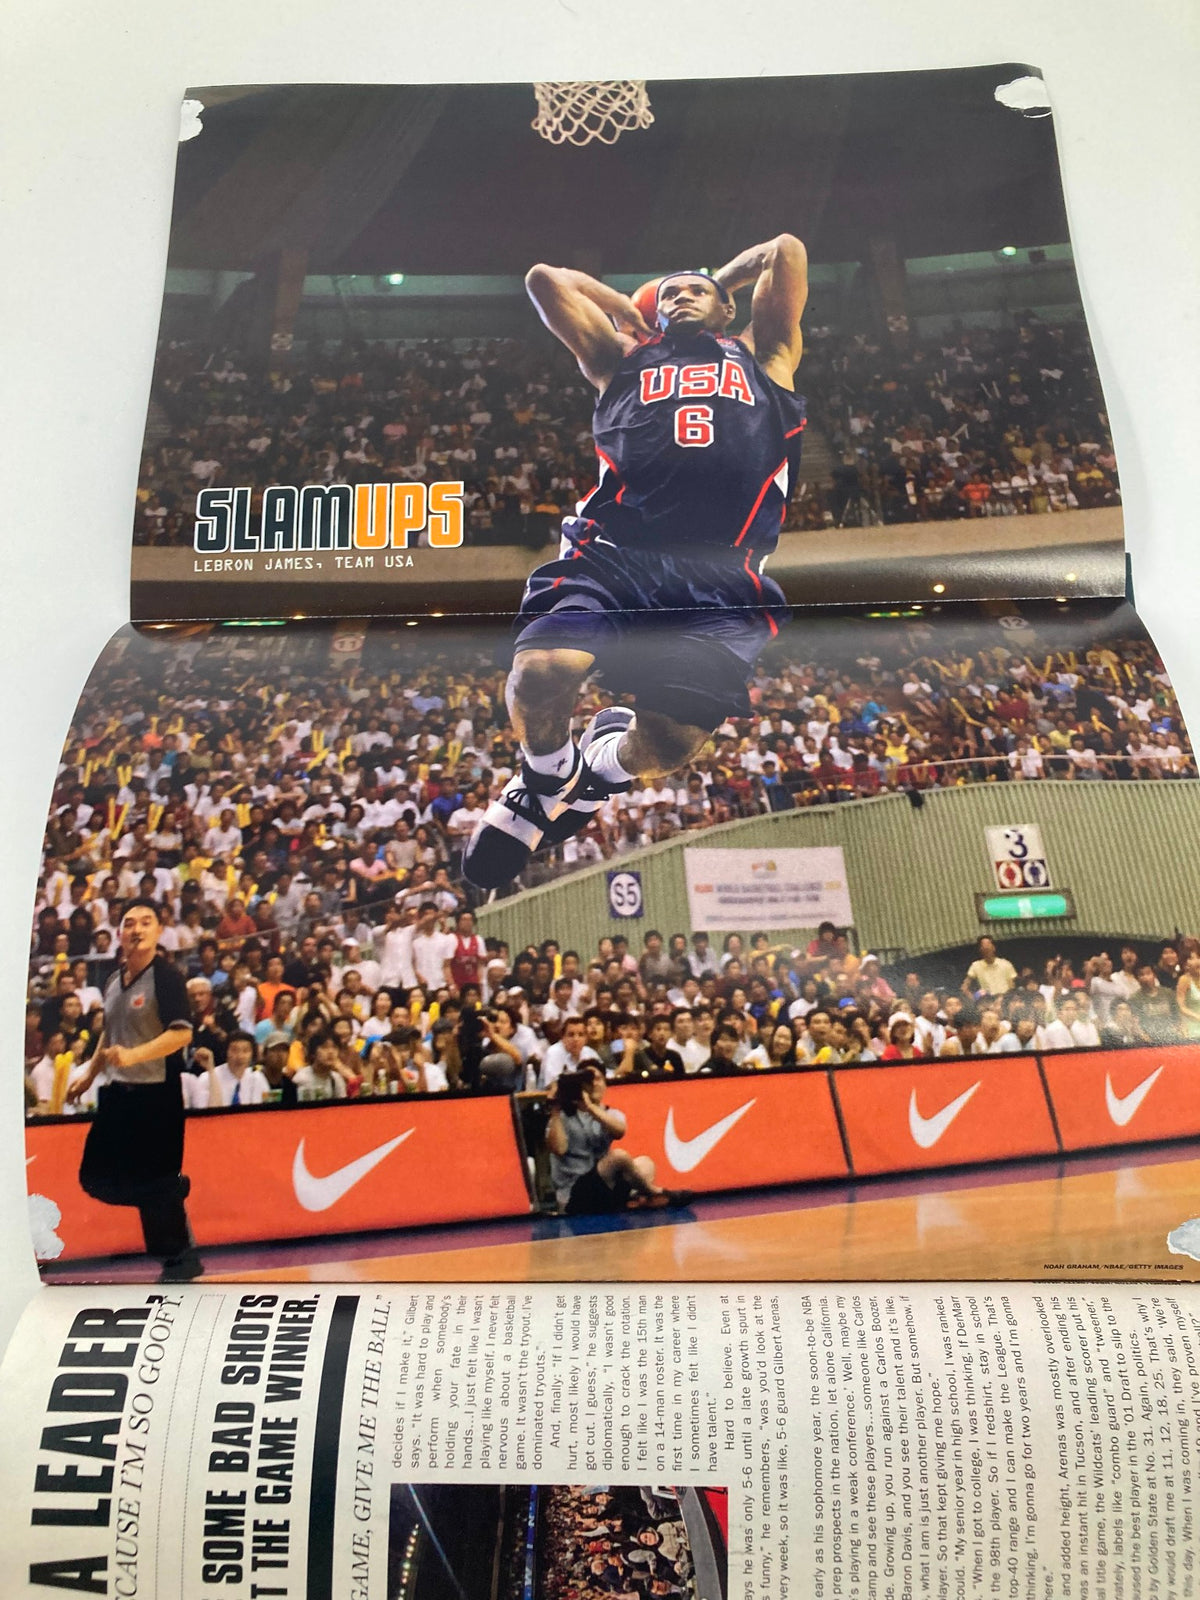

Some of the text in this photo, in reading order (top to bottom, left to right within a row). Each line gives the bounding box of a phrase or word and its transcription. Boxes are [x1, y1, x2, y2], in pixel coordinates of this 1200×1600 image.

[640, 359, 754, 406] USA
[674, 405, 714, 448] 6
[194, 555, 414, 572] LEBRON JAMES, TEAM USA
[1005, 830, 1028, 858] 3
[615, 882, 637, 906] S5
[404, 1295, 419, 1325] Gilbert
[425, 1295, 435, 1311] and
[489, 1295, 500, 1309] felt
[556, 1295, 567, 1309] get
[571, 1295, 582, 1315] have
[588, 1295, 600, 1338] suggests
[885, 1296, 896, 1315] like,
[1137, 1303, 1149, 1323] why
[420, 1313, 434, 1334] play
[488, 1311, 498, 1340] never
[520, 1313, 532, 1347] tryout.
[570, 1320, 580, 1351] would
[138, 1294, 184, 1385] GOOFY.
[419, 1338, 429, 1349] to
[468, 1335, 479, 1354] like
[586, 1343, 597, 1357] he
[890, 1338, 902, 1360] and
[993, 1331, 1007, 1377] League.
[399, 1352, 411, 1385] make
[415, 1353, 427, 1379] hard
[466, 1359, 477, 1378] felt
[484, 1351, 495, 1393] myself.
[518, 1350, 529, 1369] the
[720, 1295, 735, 1450] Hard to believe. Even at
[362, 1359, 382, 1408] THE
[431, 1369, 442, 1401] when
[444, 1295, 467, 1469] holding your fate in their
[498, 1295, 516, 1469] nervous about a basketball
[568, 1365, 581, 1395] likely
[894, 1365, 906, 1401] talent
[1000, 1383, 1011, 1404] the
[1152, 1369, 1165, 1389] 25.
[395, 1401, 405, 1410] if
[415, 1384, 424, 1409] was
[464, 1383, 477, 1407] just
[481, 1397, 492, 1419] like
[551, 1374, 564, 1414] finally:
[1156, 1395, 1169, 1416] 18,
[129, 1393, 153, 1434] SO
[516, 1417, 526, 1425] It
[569, 1402, 579, 1434] most
[897, 1405, 908, 1434] their
[934, 1418, 944, 1438] me
[1002, 1409, 1014, 1445] make
[30, 1295, 163, 1595] A LEADER,
[202, 1294, 279, 1584] SOME BAD SHOTS
[252, 1294, 320, 1572] THE GAME WINNER.
[357, 1415, 376, 1456] ME
[391, 1417, 405, 1469] decides
[427, 1417, 439, 1469] perform
[461, 1411, 474, 1469] hands...I
[479, 1423, 494, 1469] playing
[532, 1401, 544, 1470] dominated
[550, 1420, 561, 1448] And,
[586, 1422, 595, 1446] cut.
[801, 1295, 826, 1598] early as his sophomore year, the soon-to-be NBA
[1031, 1296, 1071, 1597] and added height, Arenas was mostly overlooked
[1159, 1422, 1171, 1443] 12,
[411, 1434, 423, 1468] says.
[515, 1430, 527, 1470] game.
[567, 1441, 578, 1470] hurt,
[585, 1450, 597, 1471] got
[901, 1439, 910, 1462] see
[934, 1441, 948, 1480] giving
[1006, 1450, 1016, 1474] can
[1162, 1449, 1173, 1469] 11,
[121, 1439, 146, 1492] I'M
[902, 1467, 913, 1490] you
[352, 1460, 374, 1521] GIVE
[1164, 1475, 1174, 1488] at
[901, 1494, 912, 1518] and
[936, 1483, 948, 1511] kept
[1006, 1488, 1017, 1512] and
[1166, 1492, 1175, 1512] me
[901, 1522, 913, 1561] Davis,
[937, 1516, 947, 1541] that
[1008, 1517, 1019, 1552] range
[1164, 1517, 1176, 1547] draft
[936, 1545, 948, 1562] So
[1007, 1557, 1020, 1599] top-40
